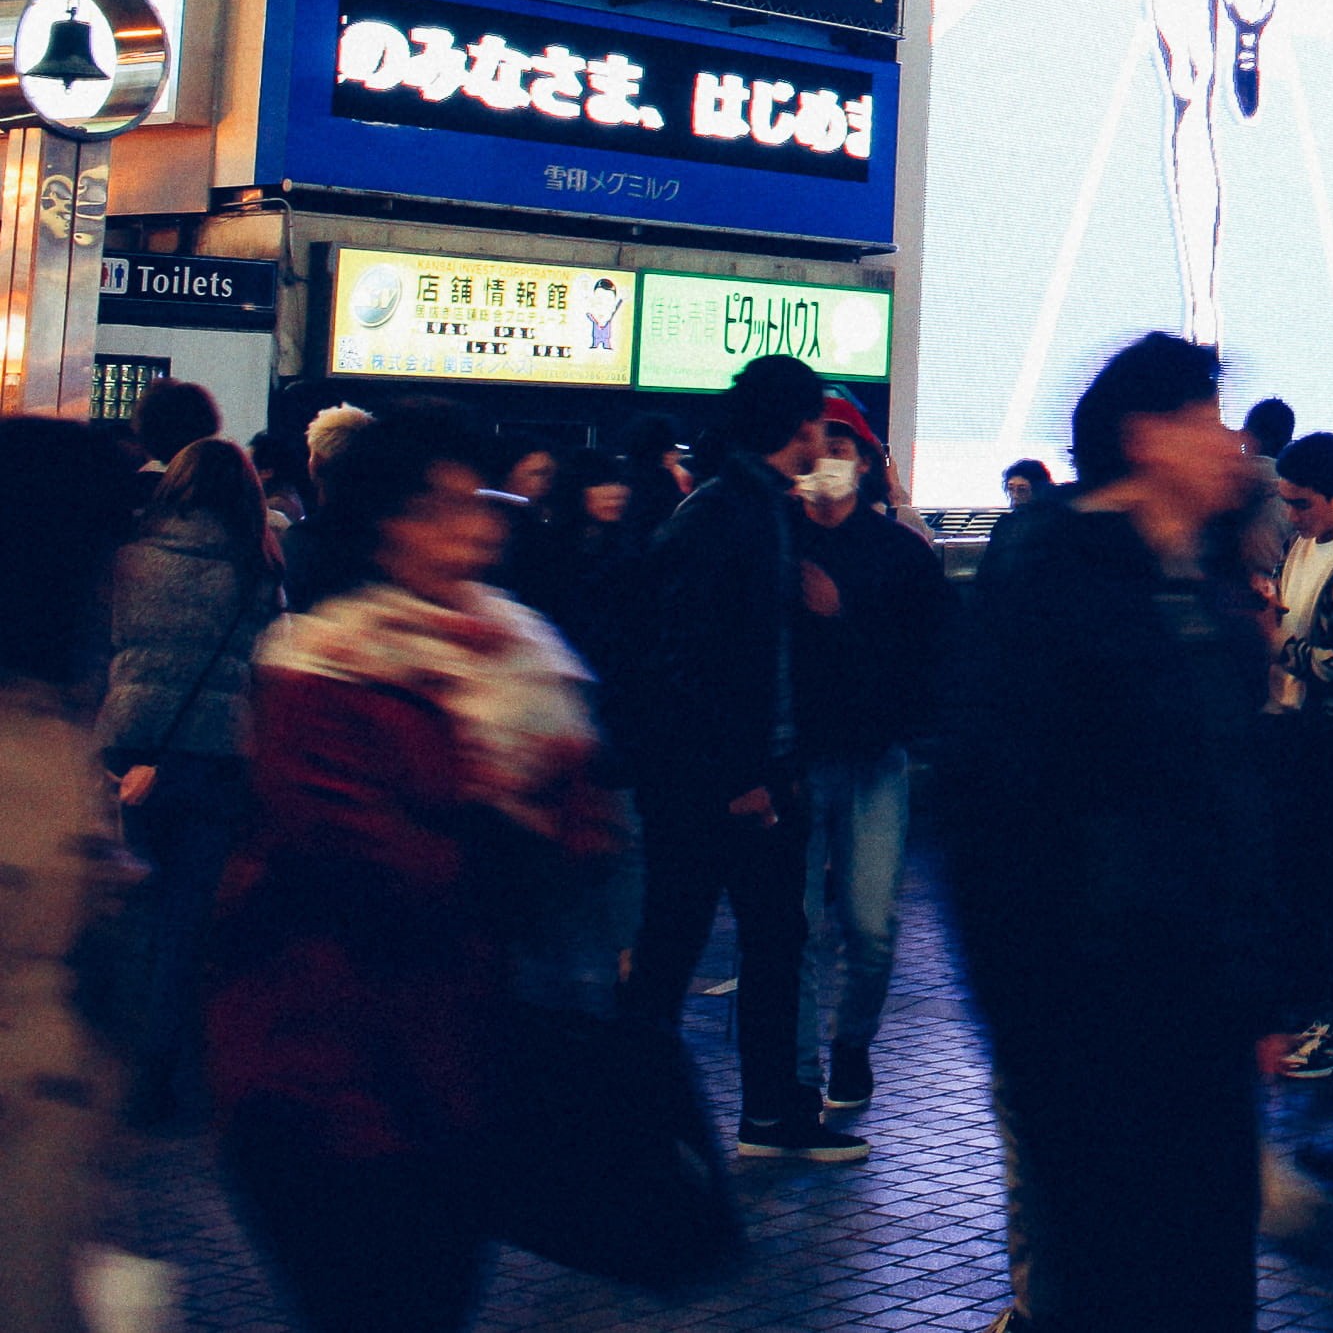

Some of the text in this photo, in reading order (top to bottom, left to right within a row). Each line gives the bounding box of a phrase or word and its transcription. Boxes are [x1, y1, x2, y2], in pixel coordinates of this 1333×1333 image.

[543, 163, 681, 202] 雪印メグミルク
[137, 266, 234, 298] Toilets
[416, 273, 569, 310] 店舗情報館
[724, 292, 821, 359] ピタットハウス
[370, 353, 436, 373] 株式会社
